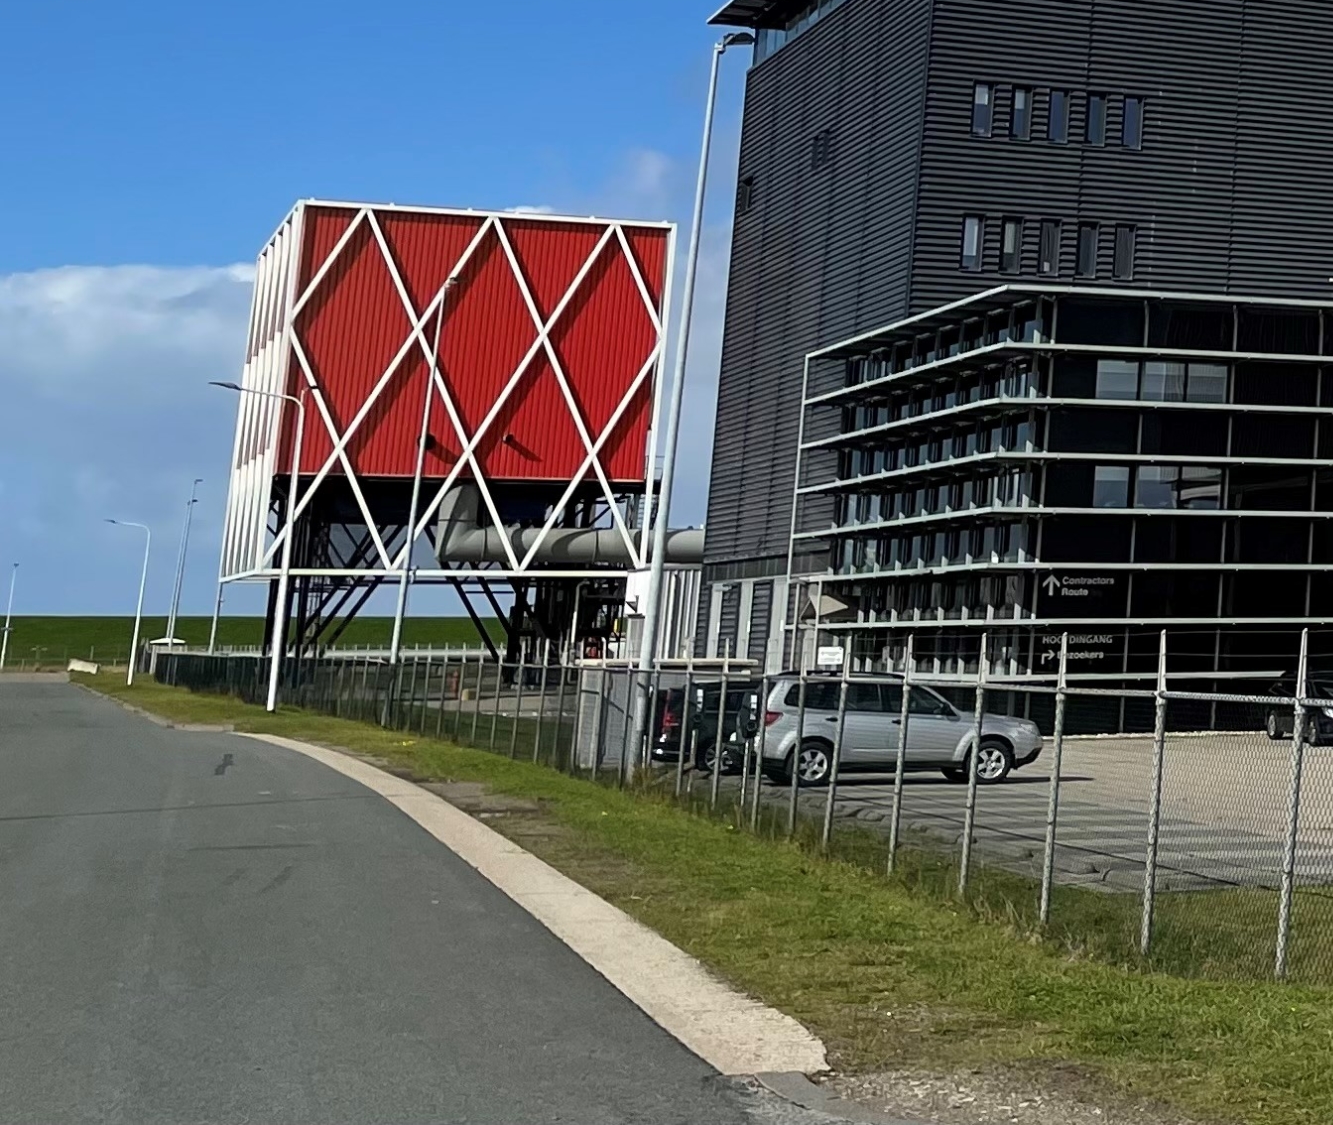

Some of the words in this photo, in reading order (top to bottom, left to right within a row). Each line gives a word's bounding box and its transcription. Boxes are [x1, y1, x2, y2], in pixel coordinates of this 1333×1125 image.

[1062, 576, 1114, 585] Contractors
[1061, 587, 1089, 596] Route
[1042, 635, 1112, 644] HOODINGANG
[1057, 650, 1104, 659] Bzoekers
